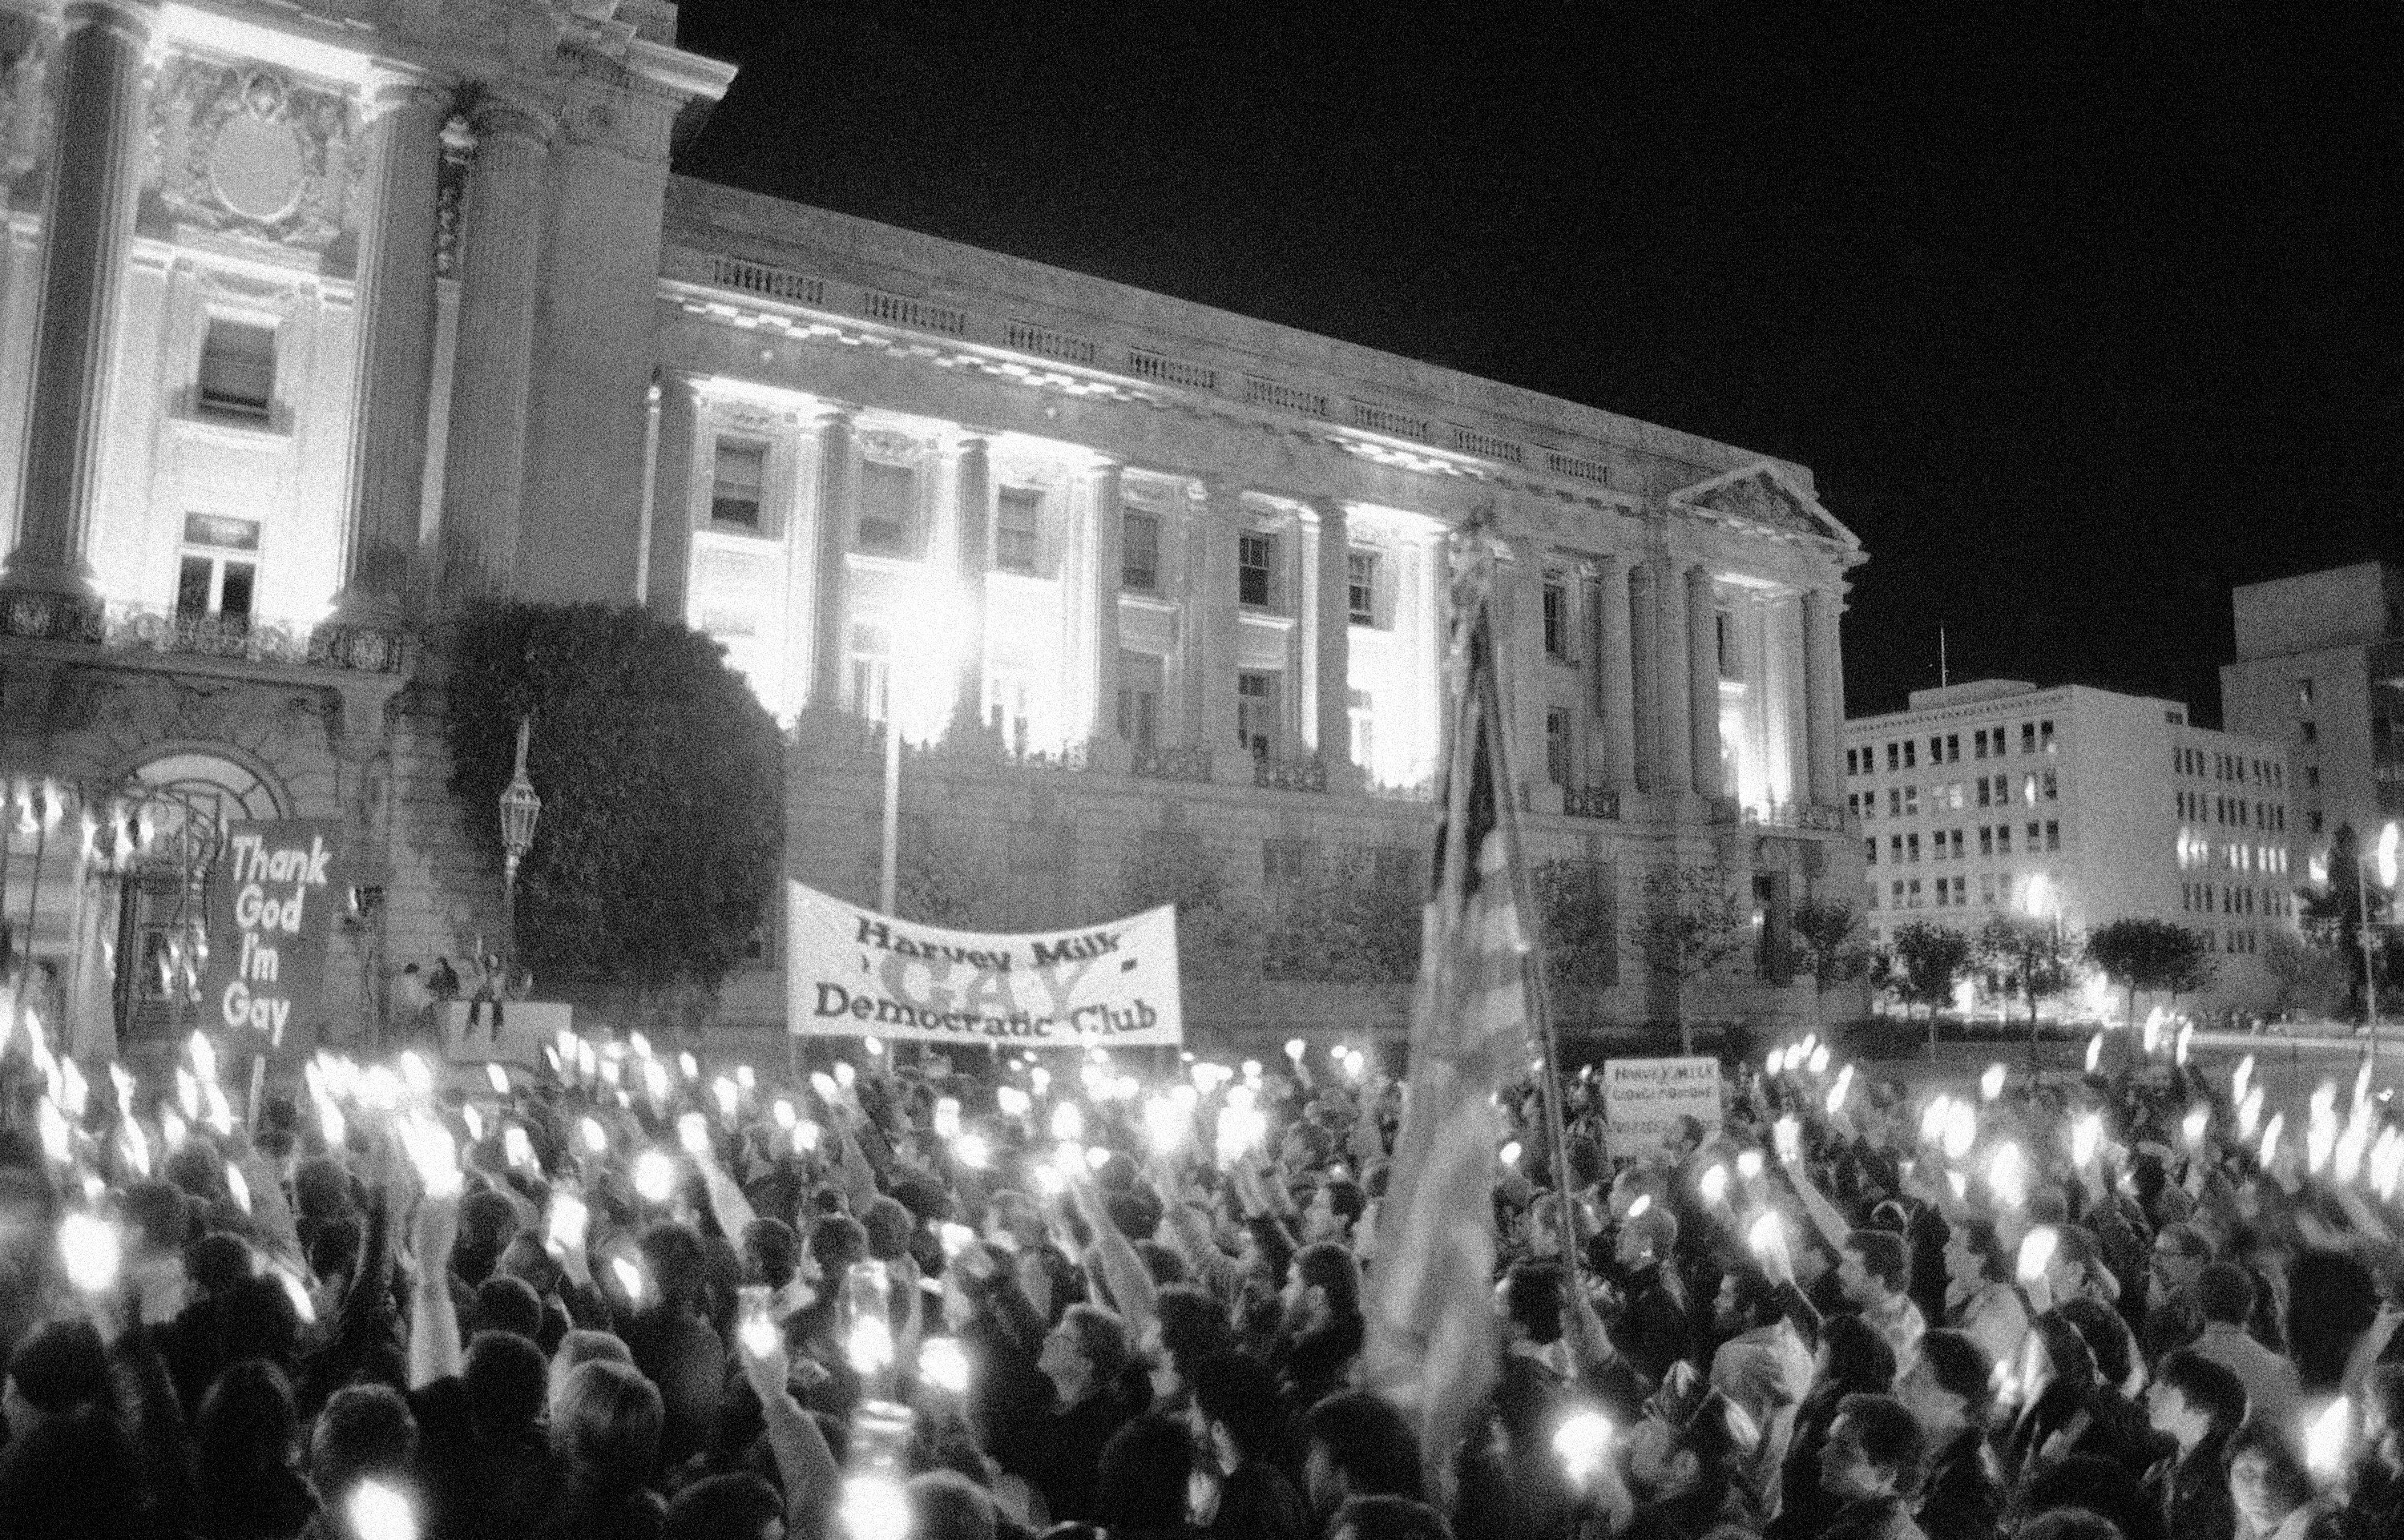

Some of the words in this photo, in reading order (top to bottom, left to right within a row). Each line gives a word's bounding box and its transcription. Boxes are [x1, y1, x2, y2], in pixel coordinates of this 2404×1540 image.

[232, 835, 332, 884] Thank
[236, 884, 306, 933] God
[240, 933, 279, 982] I'm
[856, 915, 1012, 973] Harvey
[1031, 932, 1122, 969] Milk
[223, 981, 291, 1046] Gay
[814, 982, 1054, 1037] Democratic
[1071, 998, 1157, 1036] Club
[881, 953, 1106, 1022] GAY
